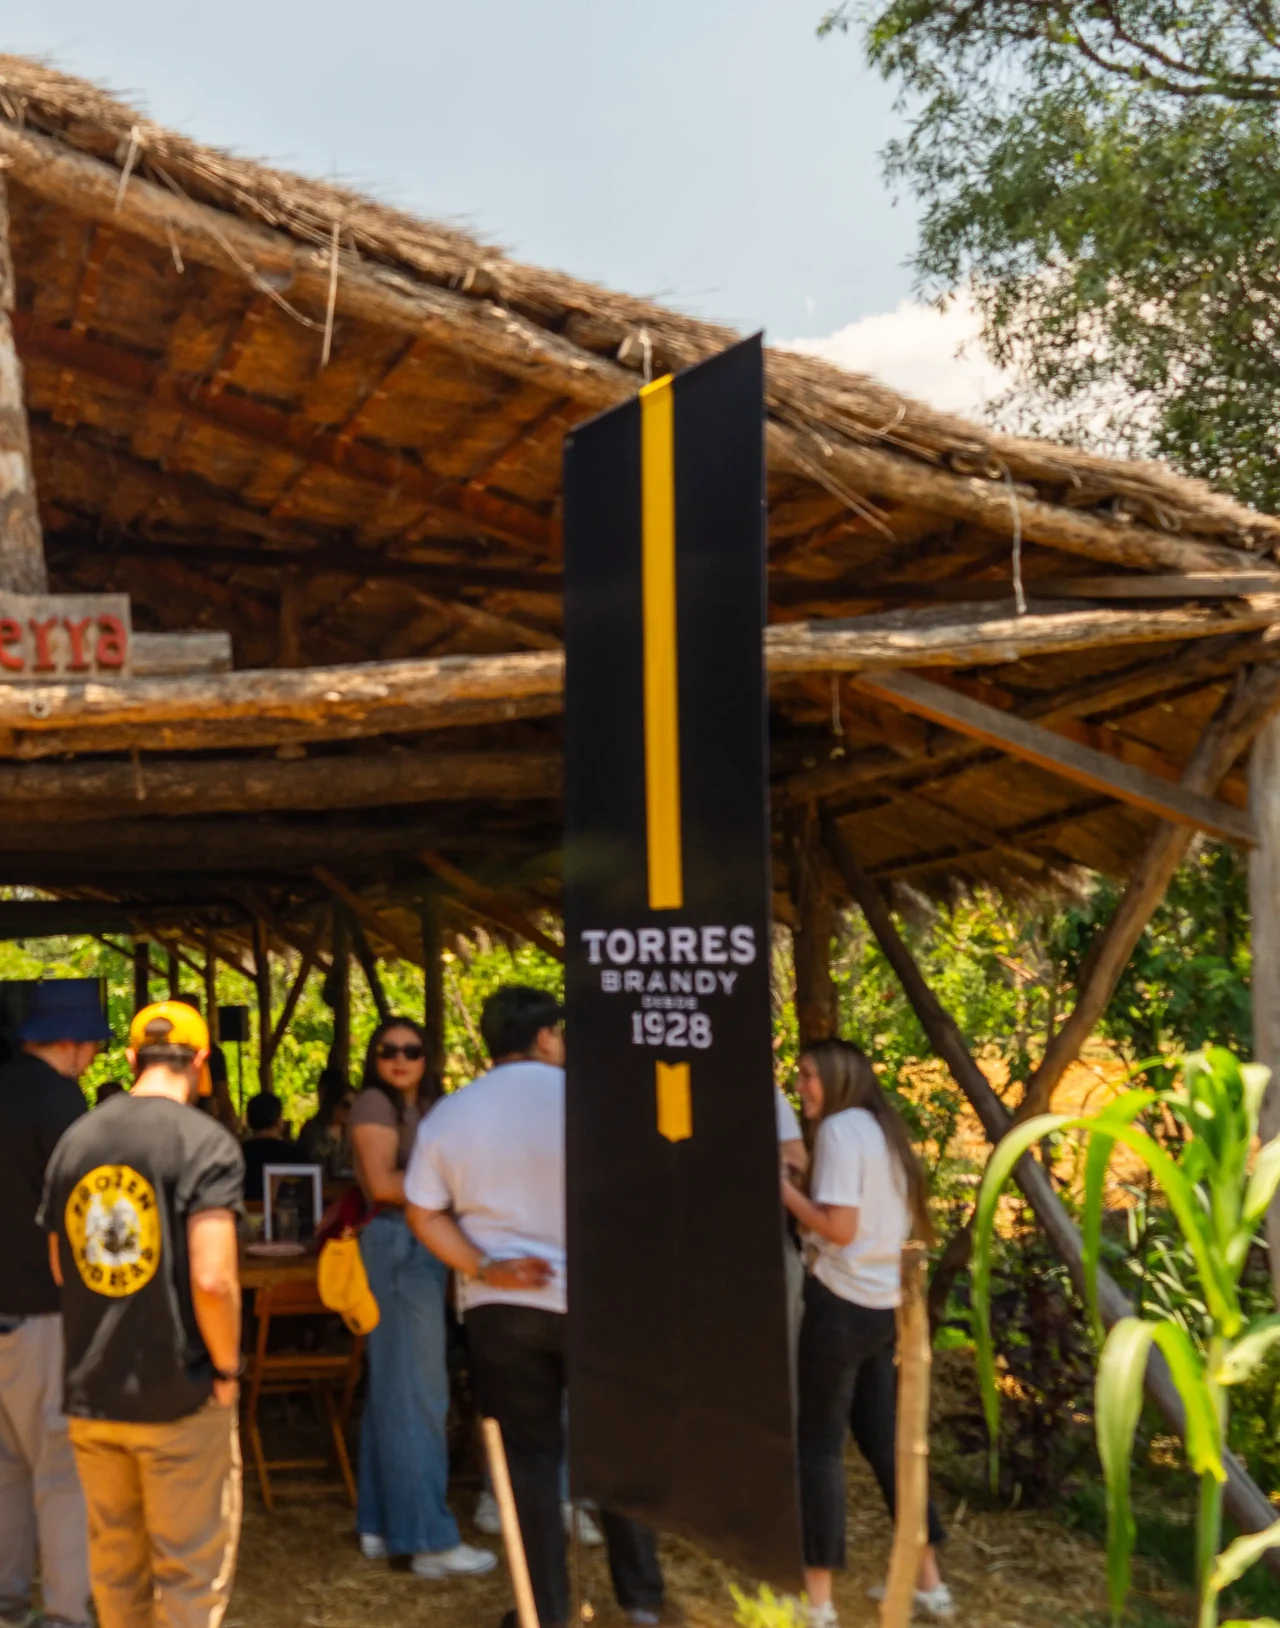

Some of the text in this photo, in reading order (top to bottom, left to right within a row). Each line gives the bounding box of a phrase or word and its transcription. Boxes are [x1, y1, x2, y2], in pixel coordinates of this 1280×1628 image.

[581, 924, 757, 966] TORRES
[601, 969, 738, 995] BRANDY
[631, 1010, 713, 1049] 1928
